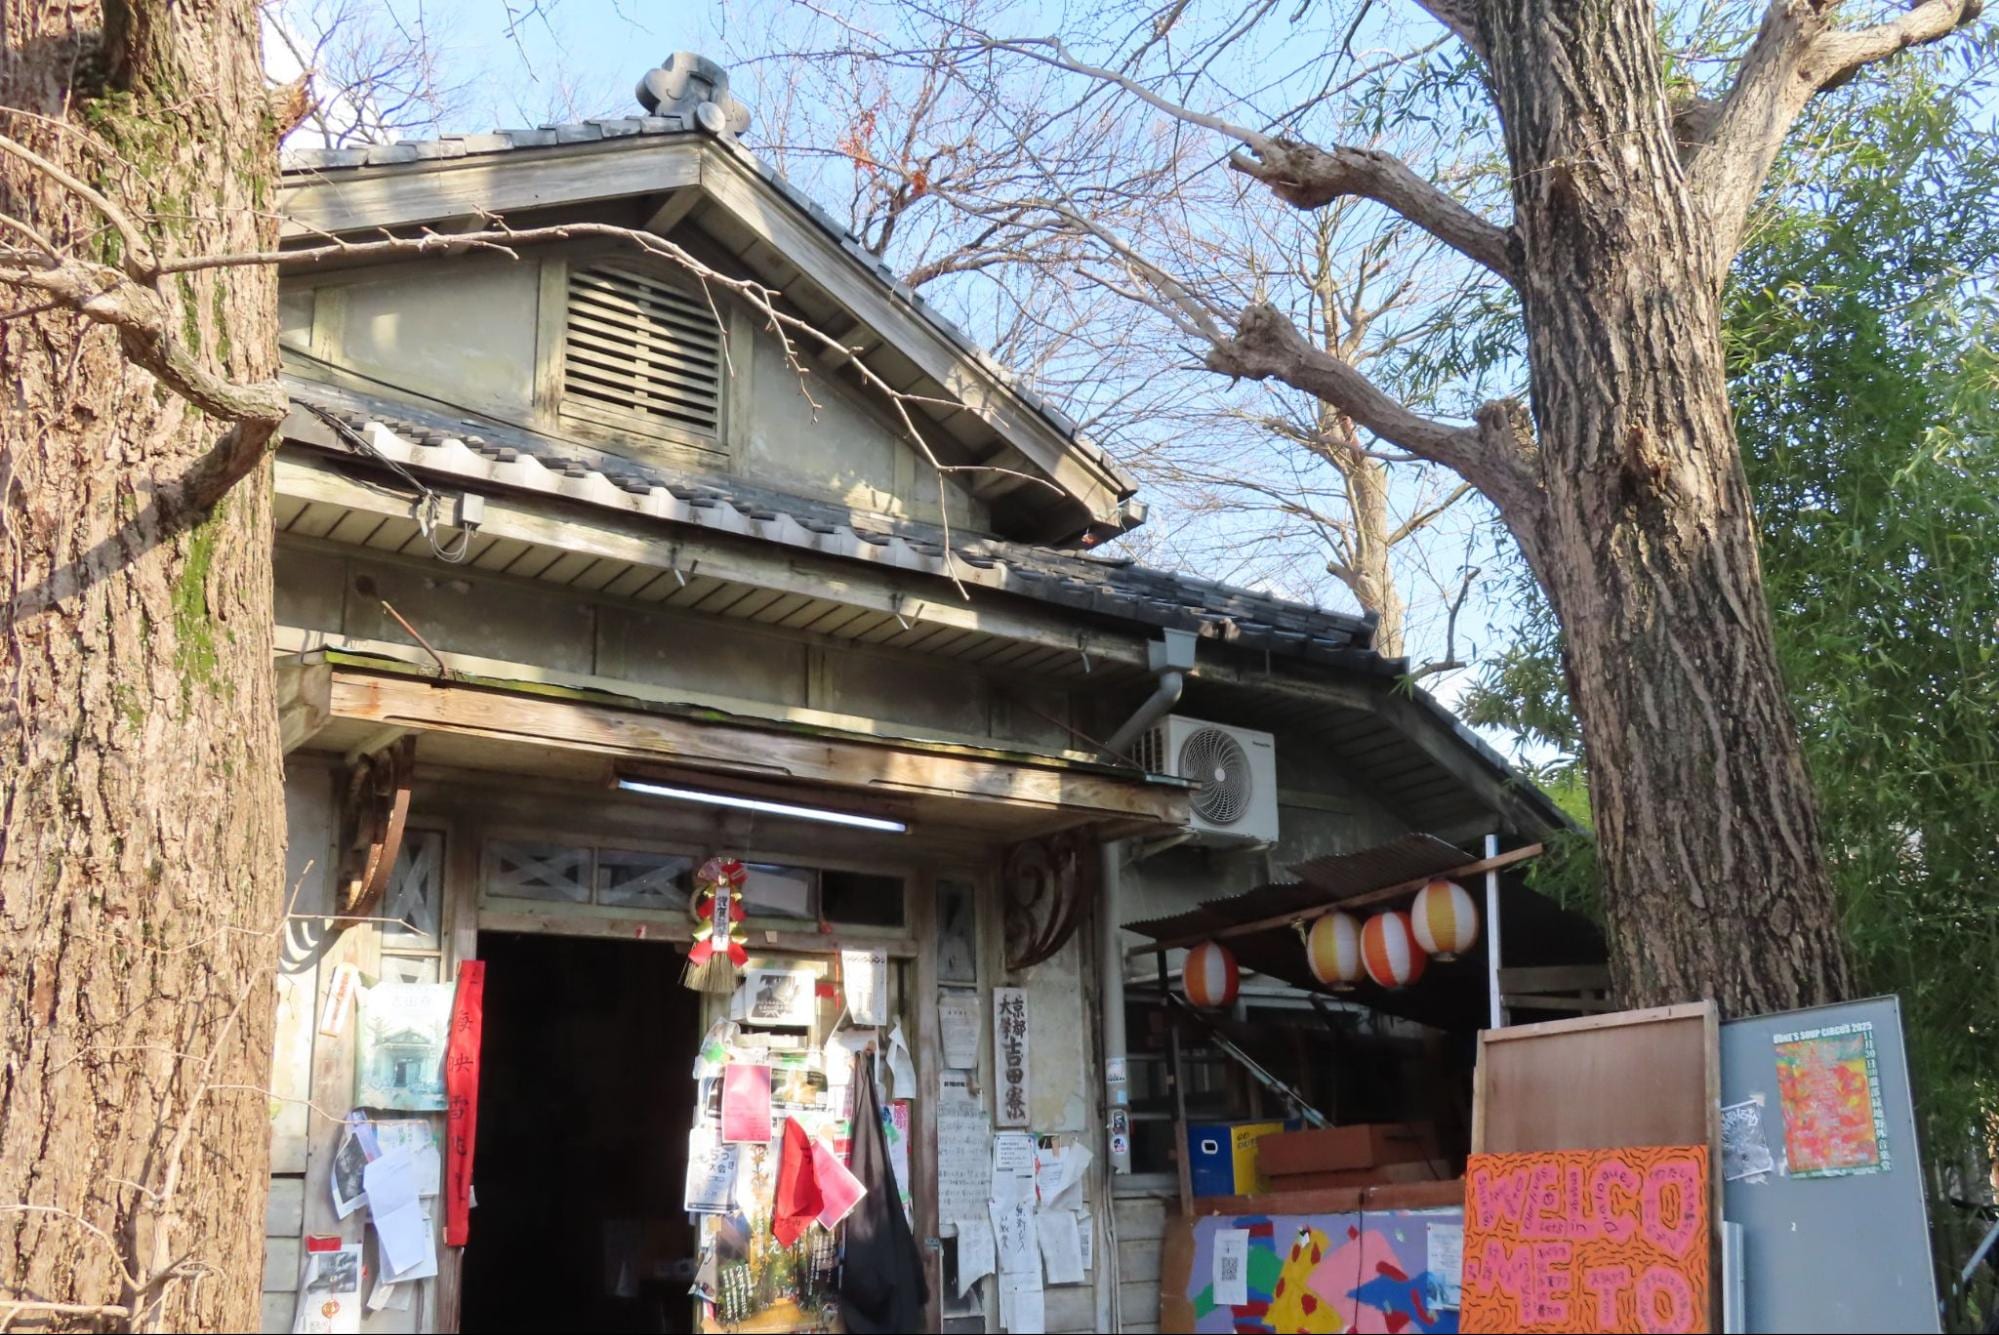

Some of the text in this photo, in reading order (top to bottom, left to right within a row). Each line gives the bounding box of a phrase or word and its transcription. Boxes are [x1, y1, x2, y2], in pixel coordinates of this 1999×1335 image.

[1011, 995, 1027, 1039] 京都
[1002, 1036, 1026, 1121] 吉田寮
[1583, 1264, 1695, 1333] TO
